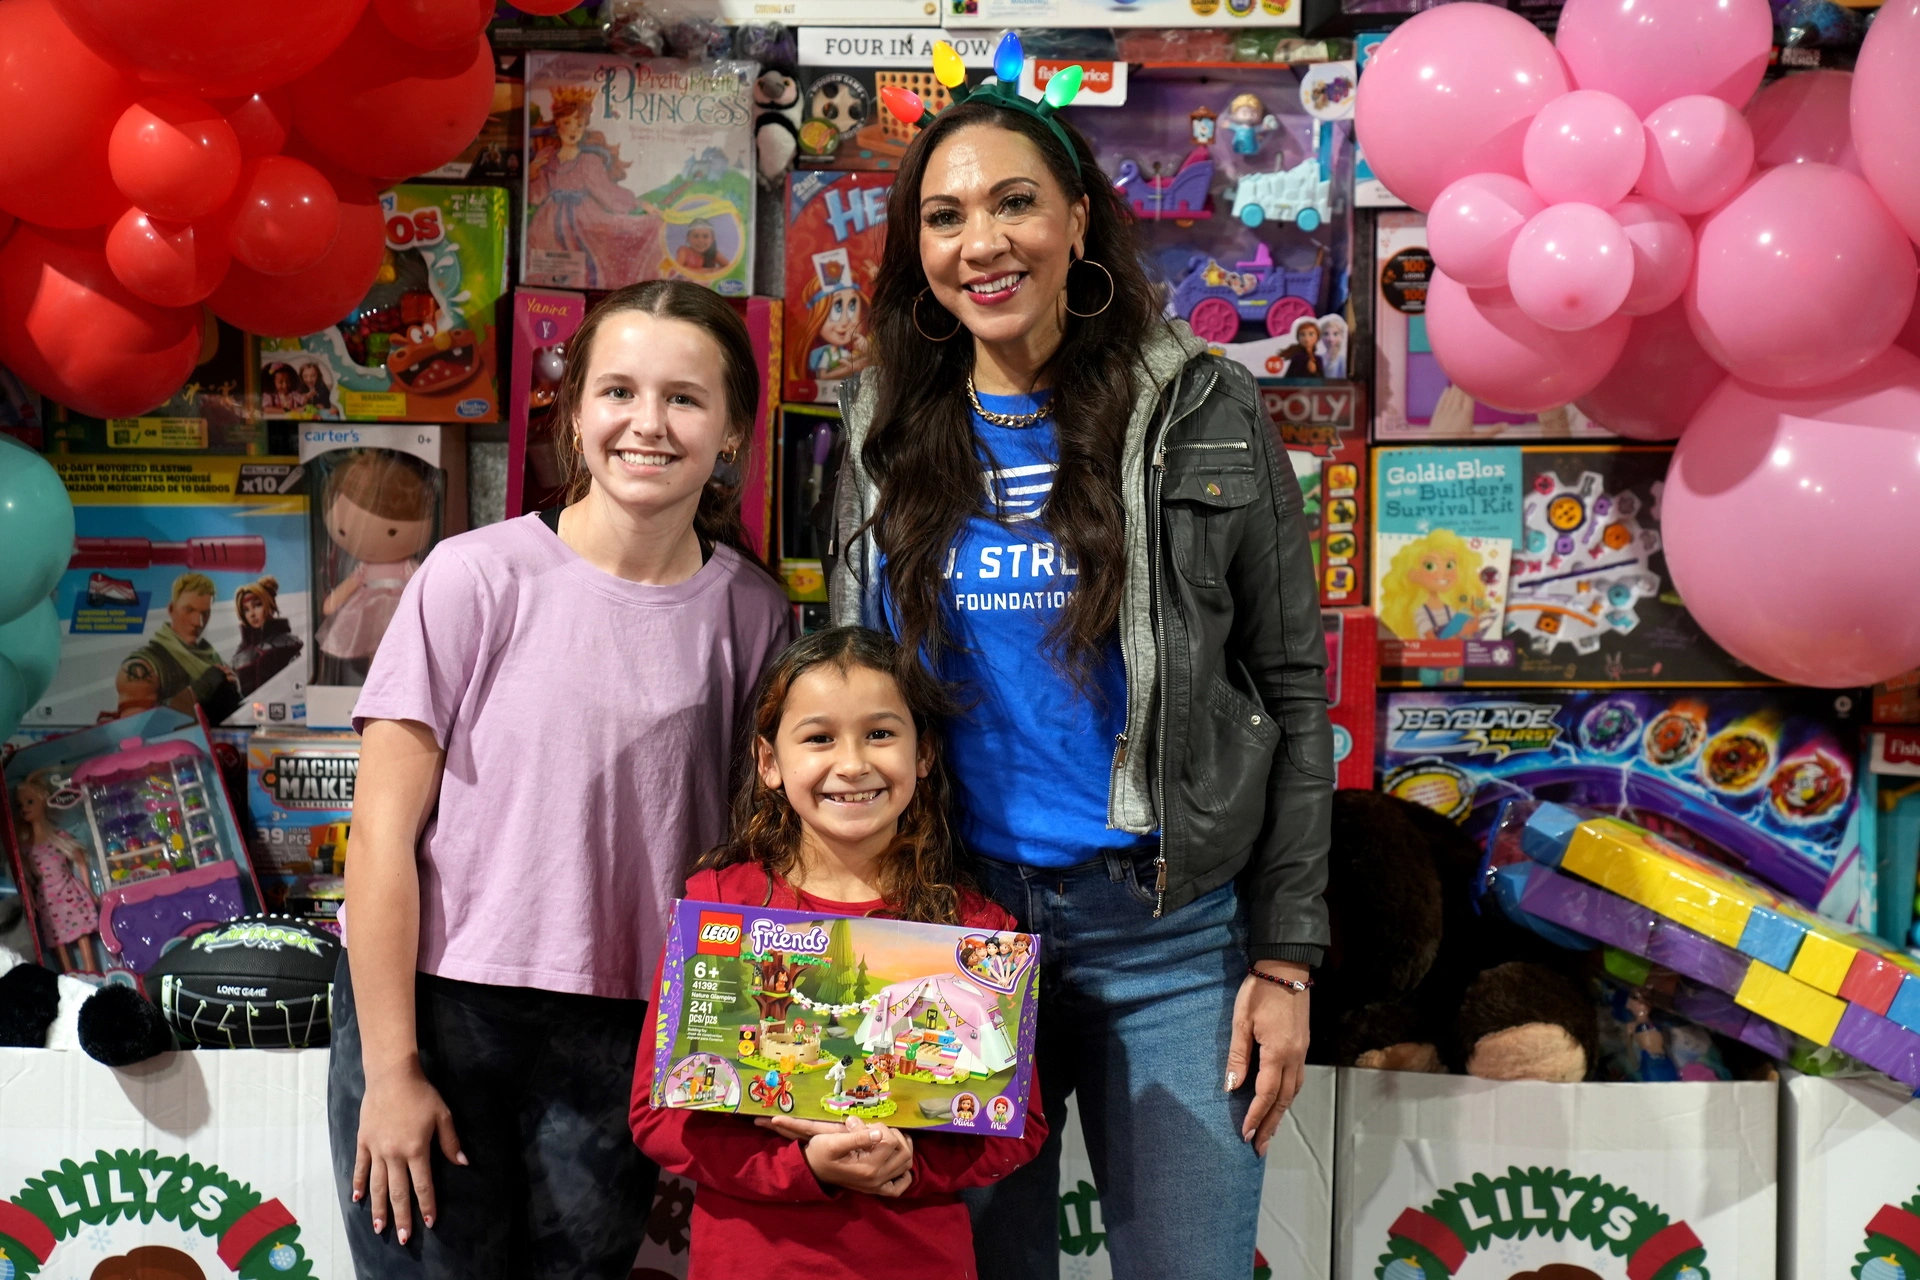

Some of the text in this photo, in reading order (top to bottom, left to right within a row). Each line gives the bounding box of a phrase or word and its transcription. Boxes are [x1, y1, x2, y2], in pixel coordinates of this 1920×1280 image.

[825, 38, 884, 55] FOUR
[890, 38, 913, 55] IN
[920, 39, 934, 55] A
[634, 66, 741, 94] Pretty Pretty
[594, 64, 751, 127] PRINCESS
[527, 297, 568, 317] Yanira
[304, 430, 360, 444] carter's
[417, 434, 433, 445] 0+
[96, 464, 148, 473] MOTORIZED
[1387, 459, 1506, 486] GoldieBlox
[107, 484, 166, 493] MOTORIZADO
[168, 484, 180, 493] DE
[194, 484, 231, 493] DARDOS
[241, 477, 278, 494] x10
[1420, 478, 1514, 502] Builder's
[1385, 496, 1515, 518] Survival Kit
[1397, 708, 1555, 730] BEYBLADE
[256, 827, 285, 845] 39
[288, 835, 312, 845] PCS
[701, 924, 739, 943] LEGO
[751, 918, 830, 957] Friends
[694, 961, 720, 979] 6+
[216, 985, 269, 998] LONG GAME
[692, 981, 719, 991] 41392
[691, 991, 737, 1004] Nature Glamping
[689, 1001, 713, 1015] 241
[688, 1012, 718, 1027] pcs/pzs
[952, 1117, 976, 1128] Olivia
[990, 1121, 1008, 1131] Mia
[47, 1167, 229, 1222] LILY'S
[1458, 1185, 1639, 1242] LILY'S
